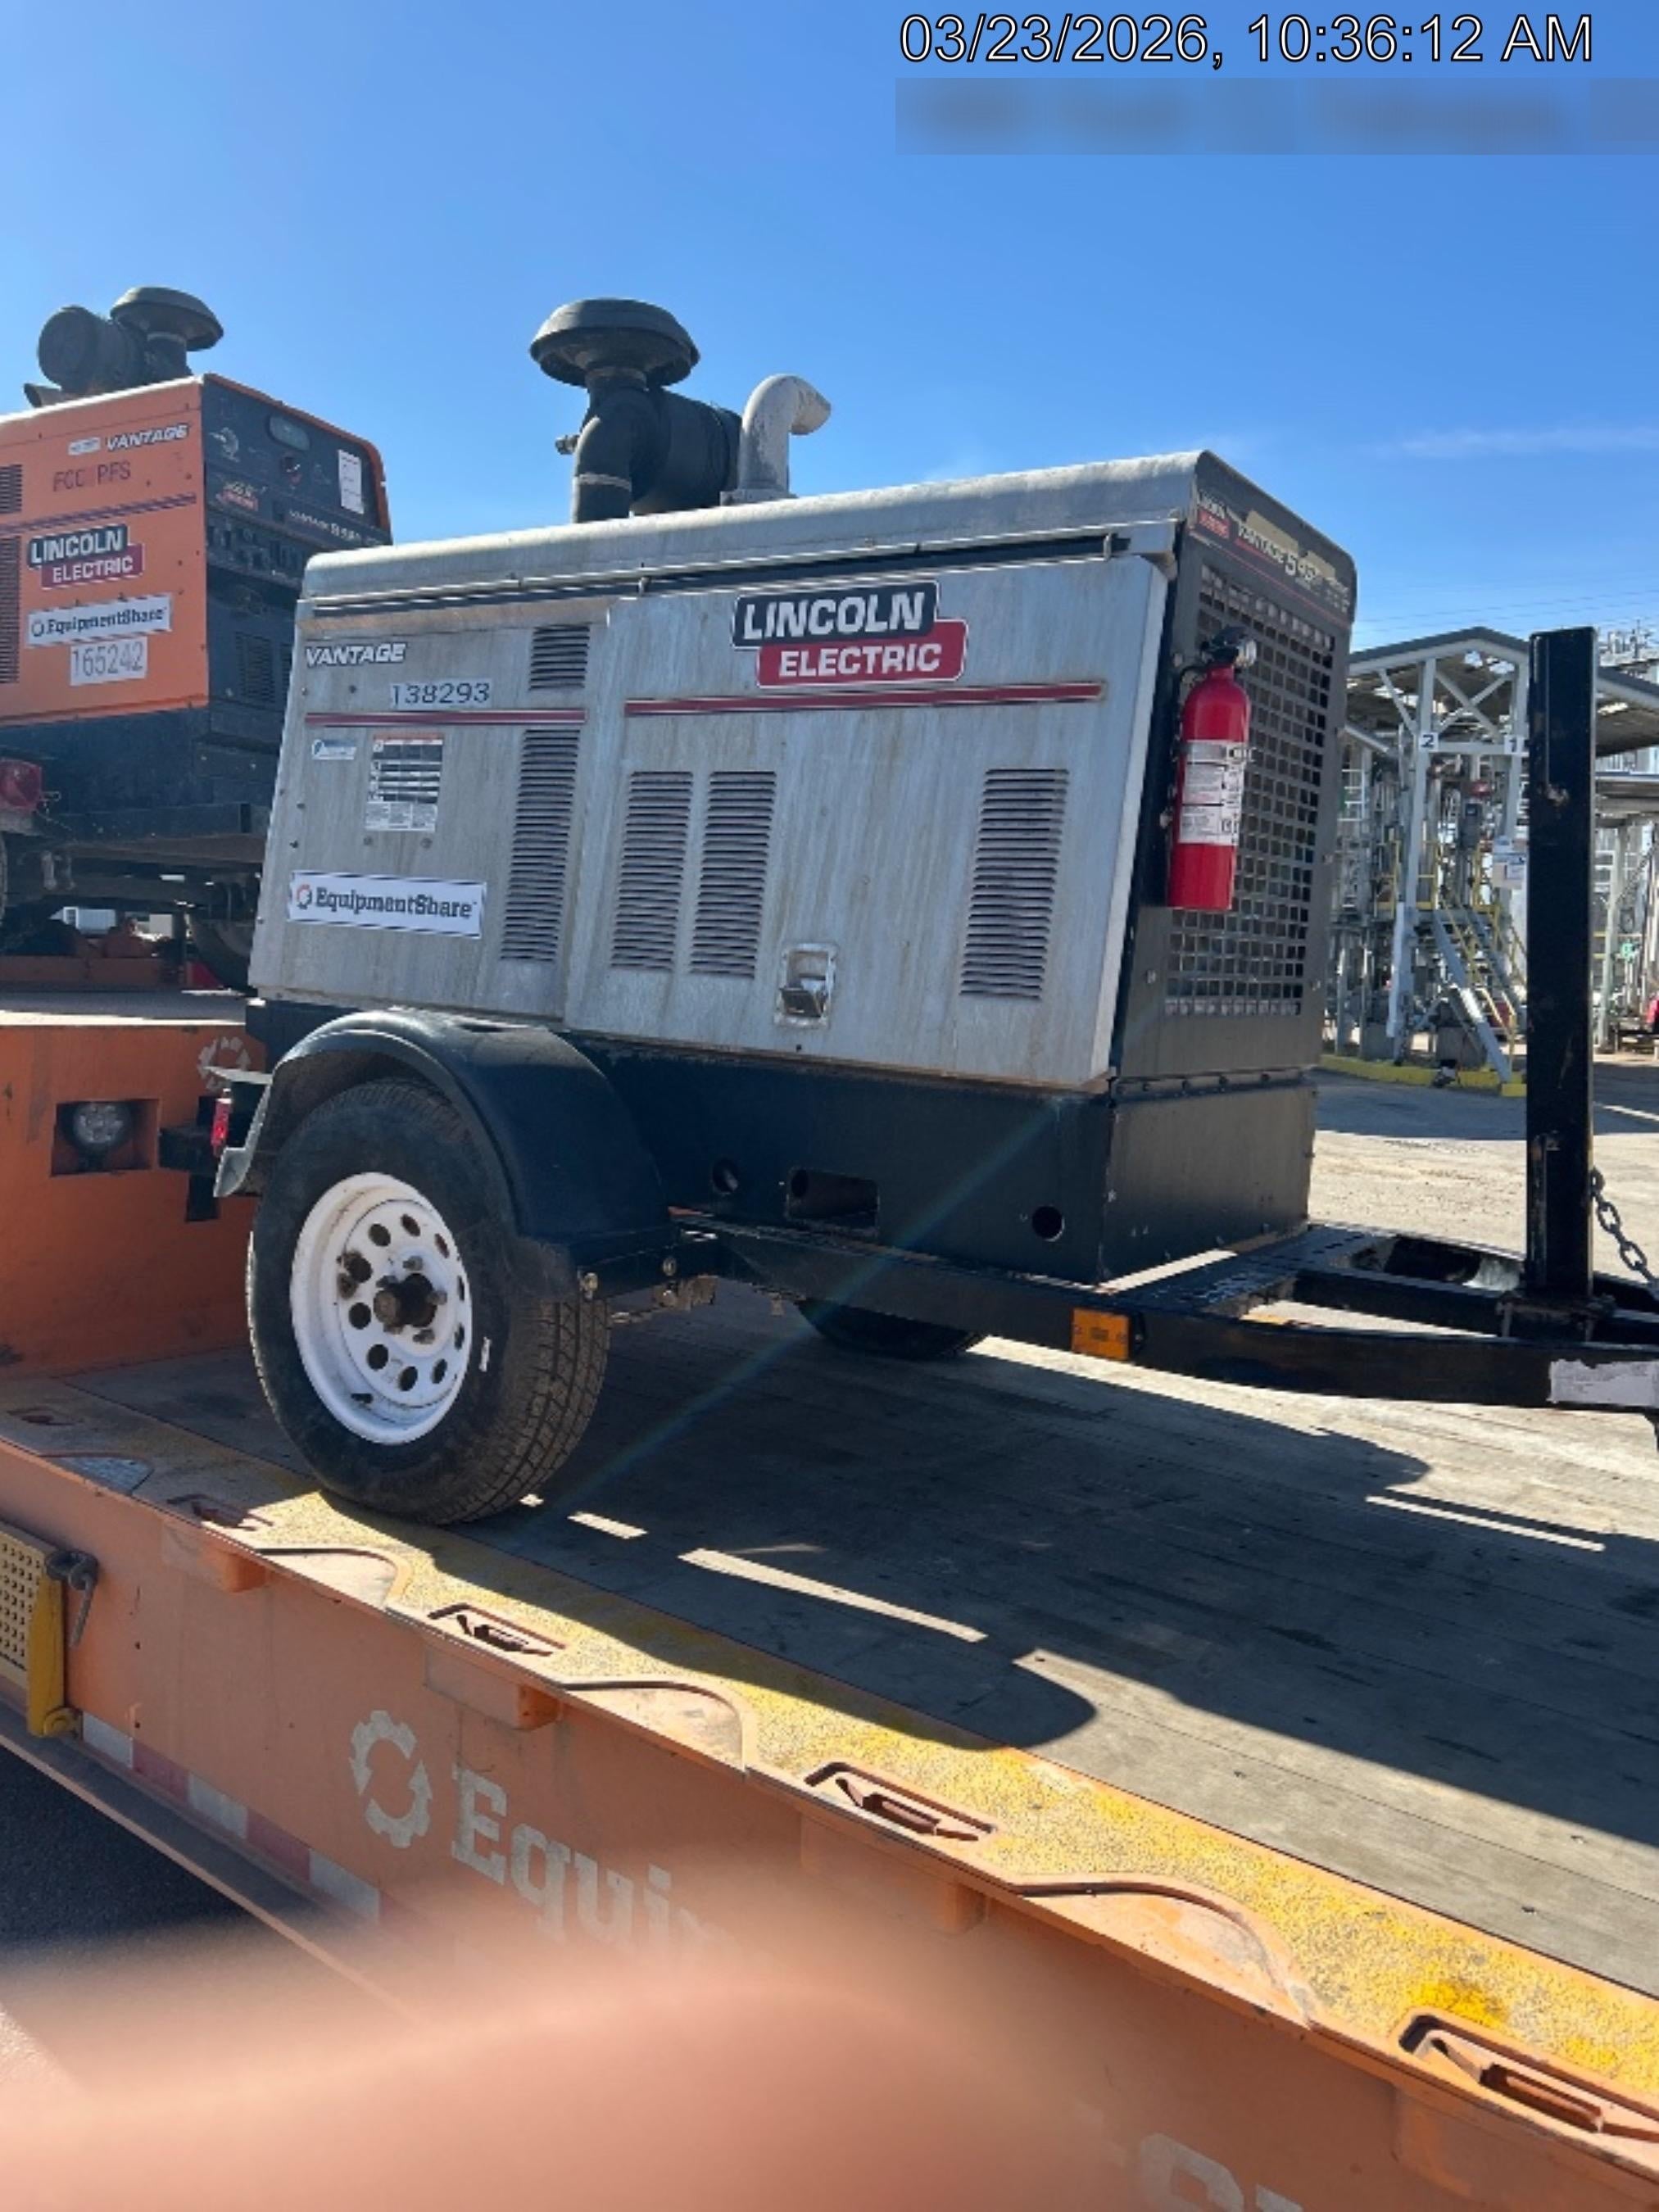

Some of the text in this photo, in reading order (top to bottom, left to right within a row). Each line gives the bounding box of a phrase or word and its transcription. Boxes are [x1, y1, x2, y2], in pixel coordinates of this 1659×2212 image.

[107, 424, 188, 451] VANTAGE
[30, 528, 123, 565] LINCOLN
[52, 555, 134, 583] ELECTRIC
[47, 608, 164, 635] EquipmentShare
[744, 592, 925, 640] LINCOLN
[72, 641, 144, 678] 165242
[306, 643, 407, 669] VANTAGE
[779, 643, 942, 677] ELECTRIC
[391, 682, 491, 706] 138293
[1421, 734, 1434, 747] 2
[316, 886, 474, 919] EquipmentShare
